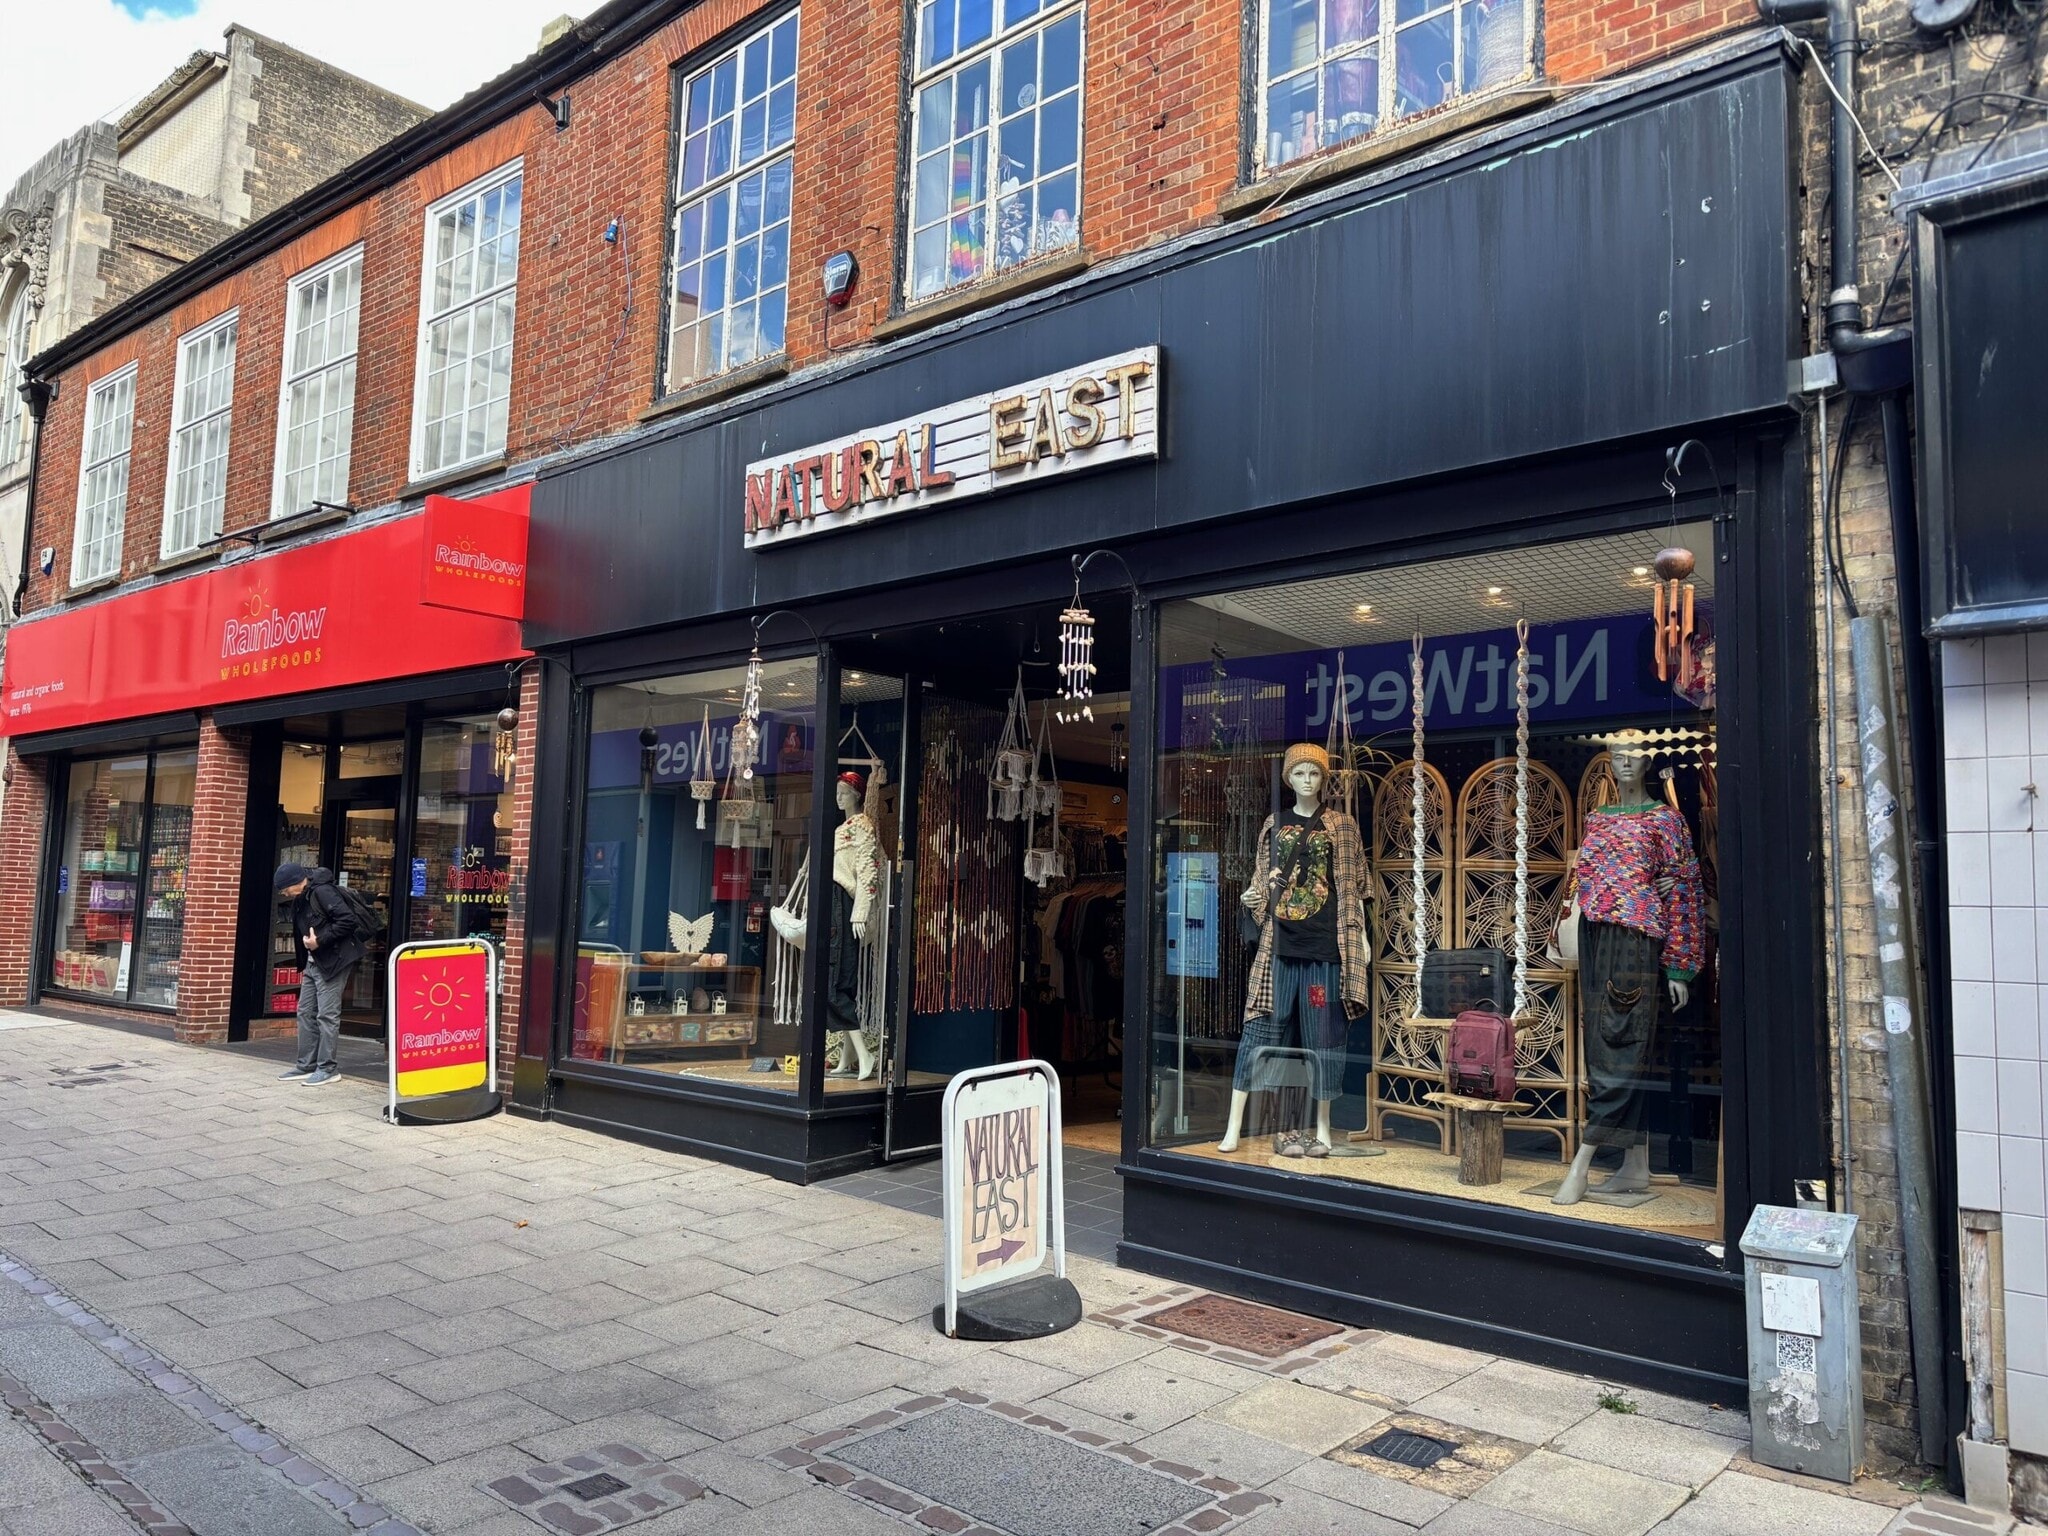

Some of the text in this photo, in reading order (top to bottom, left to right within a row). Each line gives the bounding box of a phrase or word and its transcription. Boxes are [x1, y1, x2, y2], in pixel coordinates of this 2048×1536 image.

[744, 361, 1151, 535] NATURAL EAST
[435, 544, 523, 577] Rainbow
[435, 565, 522, 587] WHOLEFOODS
[221, 606, 327, 659] Rainbow
[220, 647, 322, 681] WHOLEFOODS
[402, 1027, 482, 1050] Rainbow
[402, 1042, 481, 1059] WHOLEFOODS
[963, 1106, 1039, 1187] NATURAL
[971, 1168, 1035, 1244] EAST
